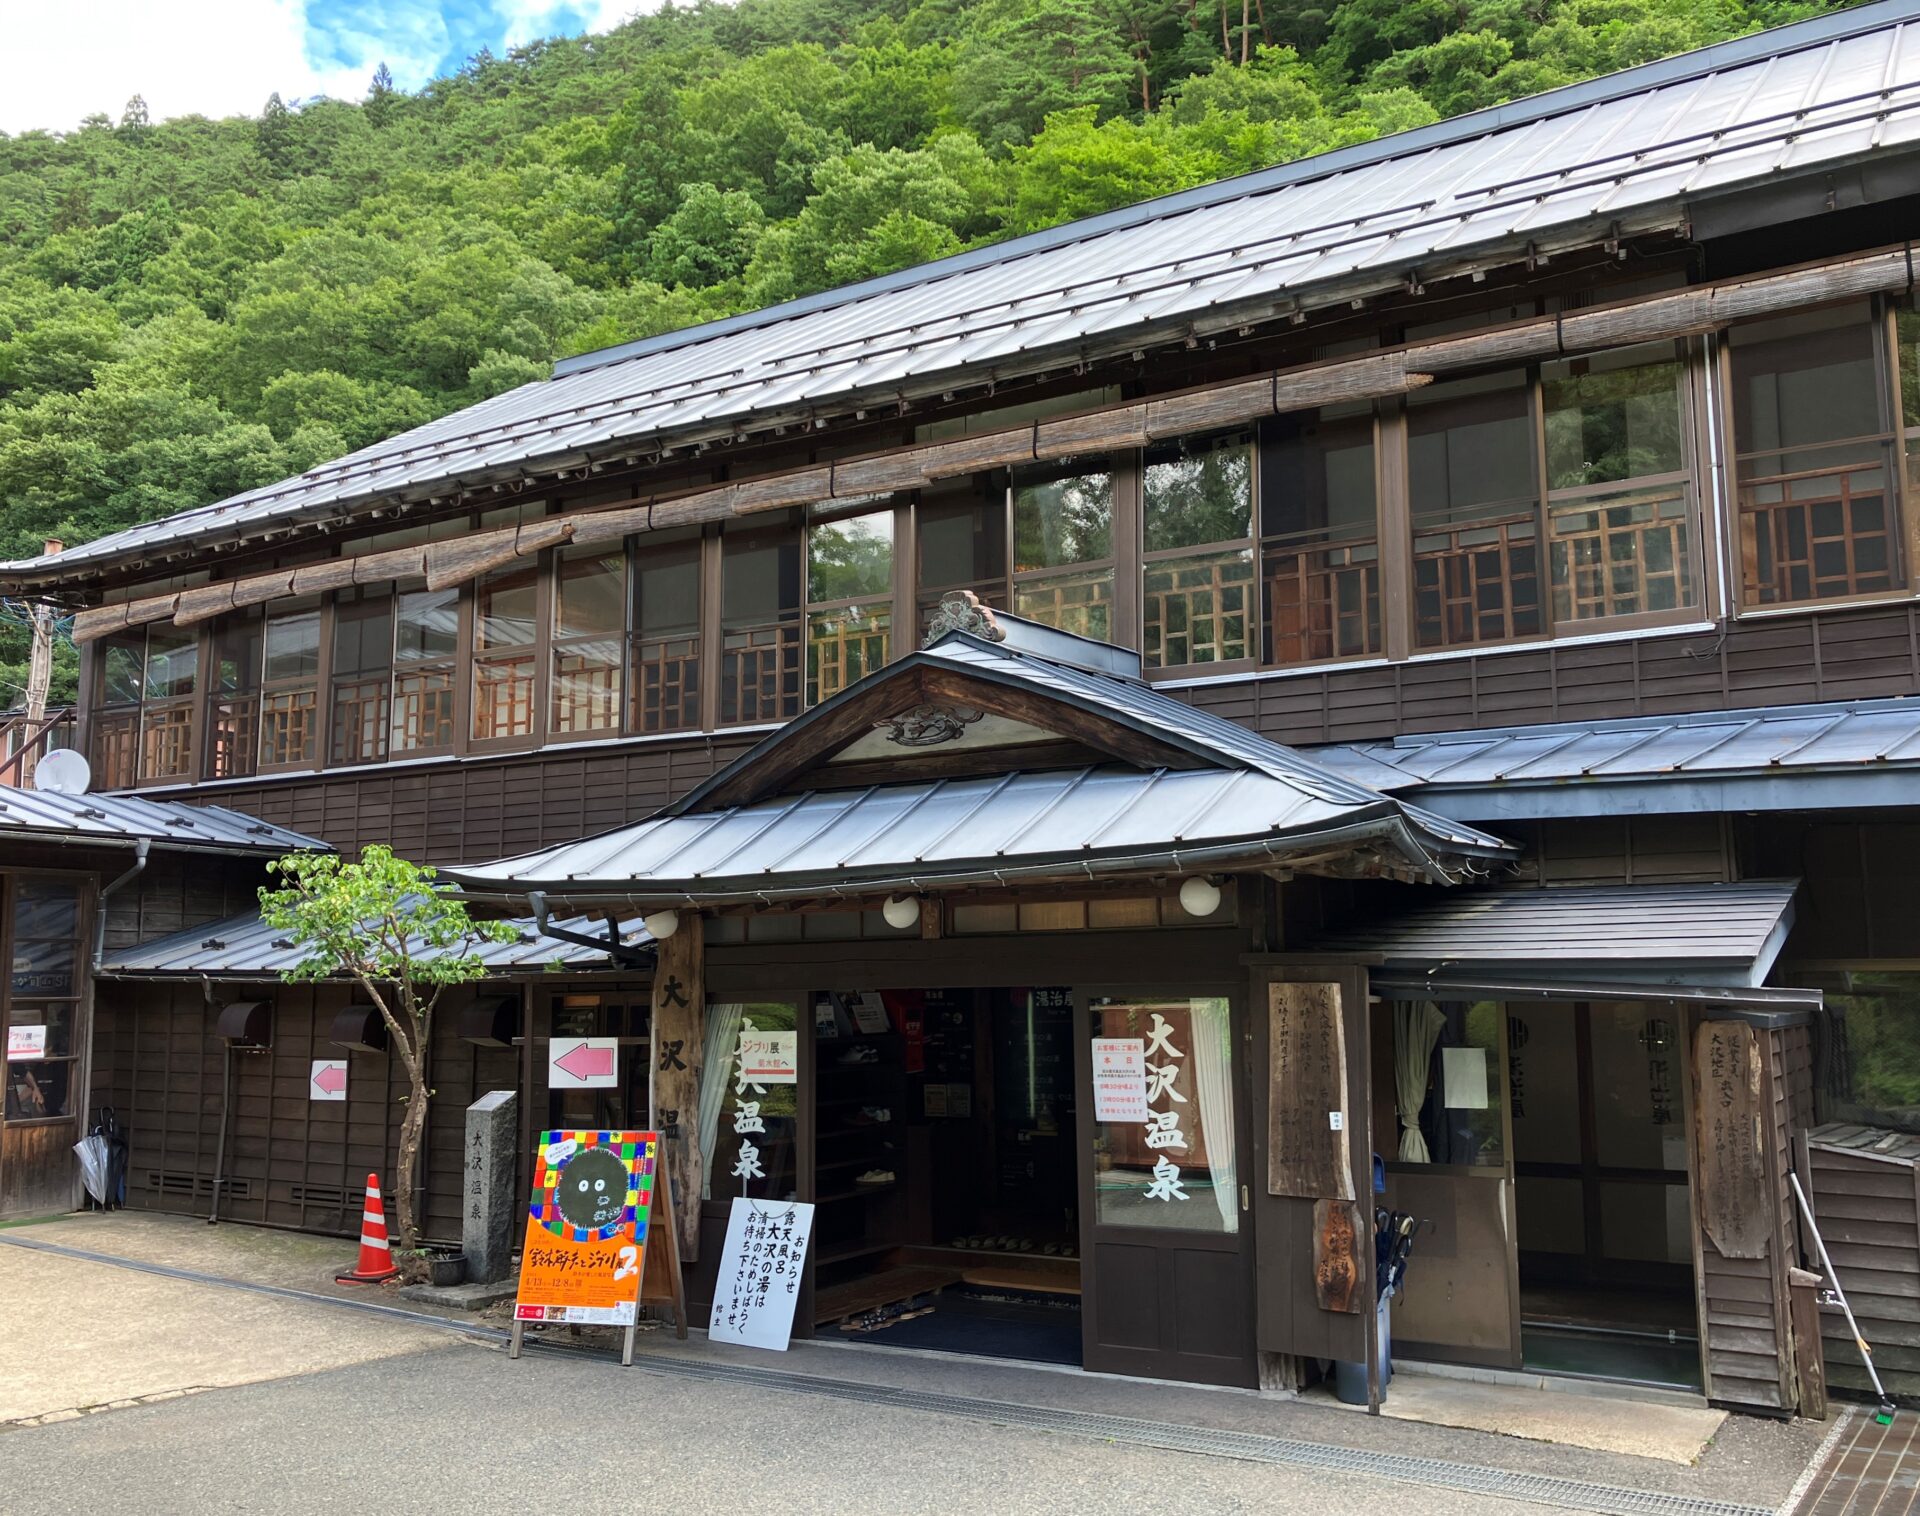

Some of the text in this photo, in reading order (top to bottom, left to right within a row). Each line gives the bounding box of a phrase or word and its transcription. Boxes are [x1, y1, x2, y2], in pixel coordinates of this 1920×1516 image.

[743, 1039, 780, 1054] ジブリ展
[1097, 1044, 1139, 1052] お客様にご案内
[1710, 1033, 1724, 1078] 大沢地区
[1143, 1013, 1190, 1202] 大沢温泉
[1721, 1080, 1734, 1107] 出入口
[471, 1131, 483, 1220] 大沢温泉
[738, 1211, 768, 1334] 清掃のためしばらく
[755, 1222, 781, 1308] 大沢の湯は
[775, 1211, 796, 1274] 露天風呂
[786, 1235, 804, 1294] お知らせ
